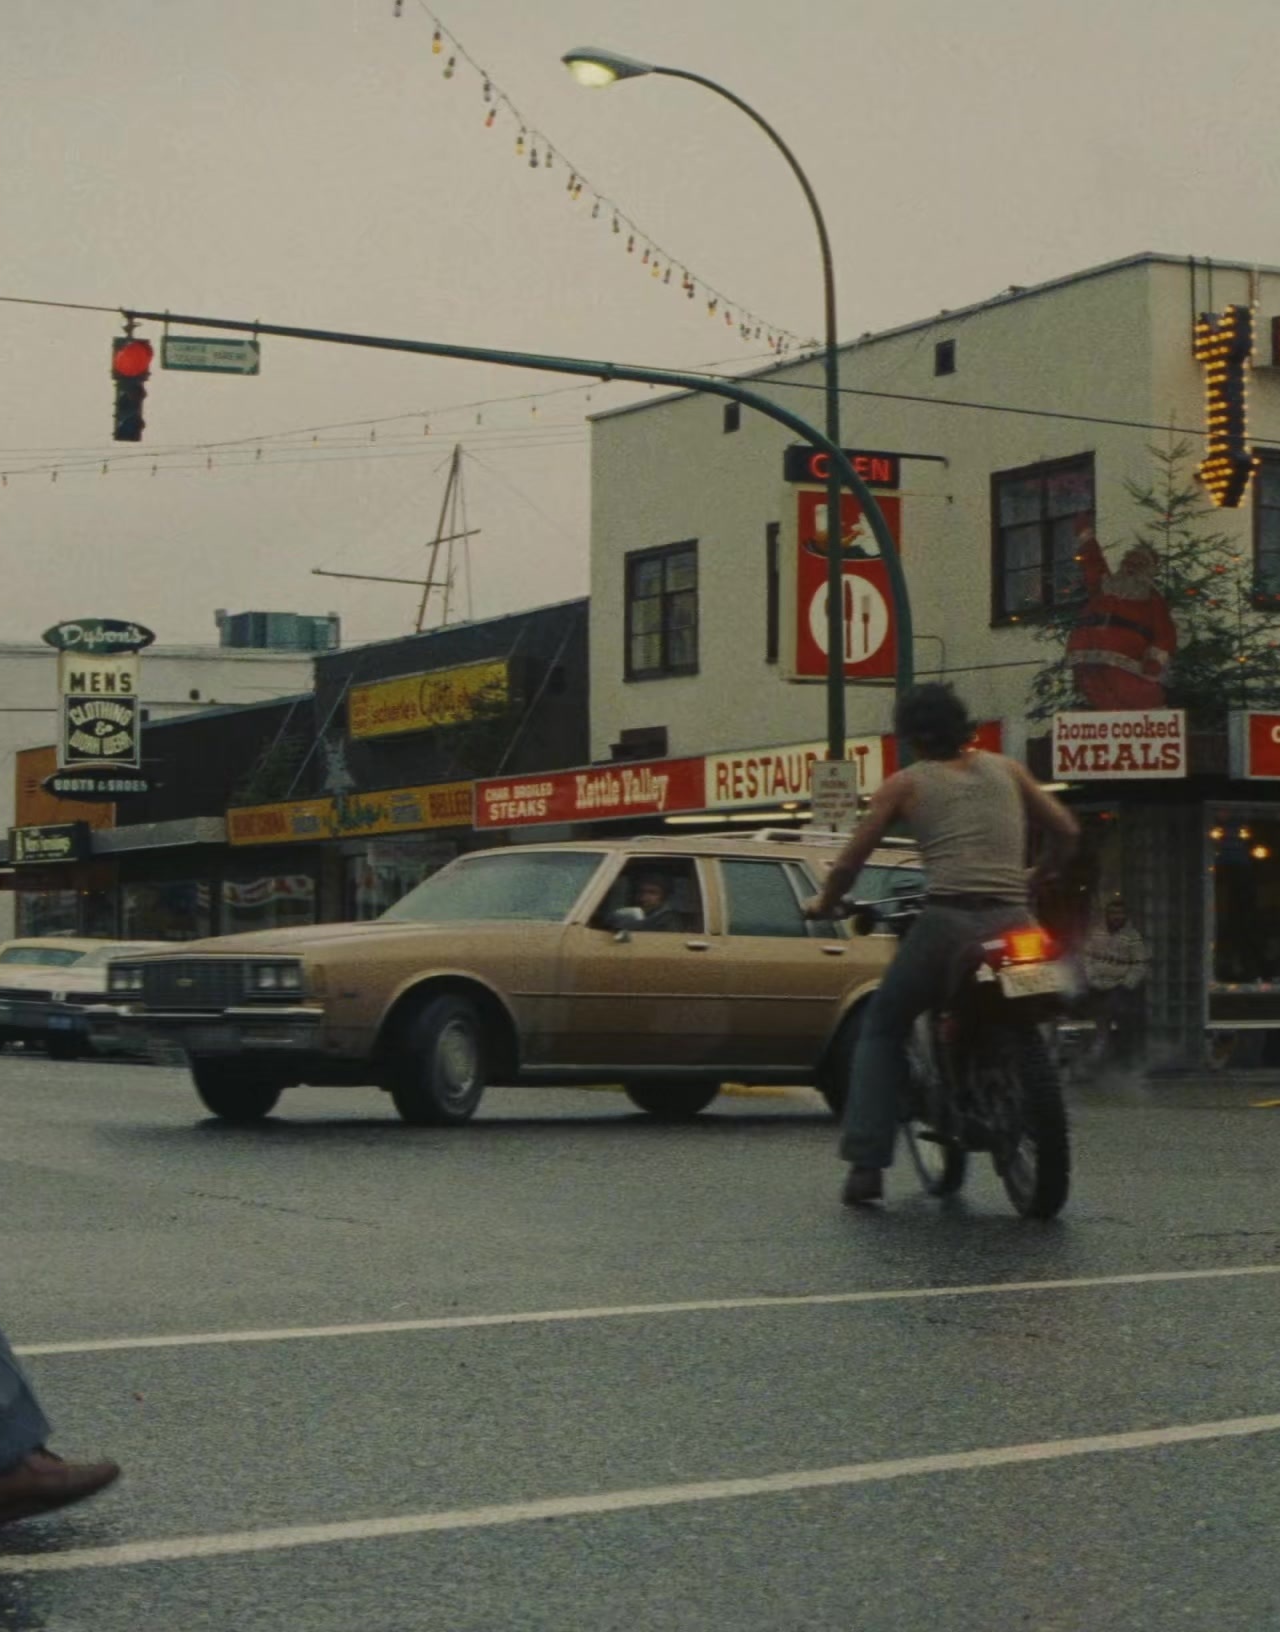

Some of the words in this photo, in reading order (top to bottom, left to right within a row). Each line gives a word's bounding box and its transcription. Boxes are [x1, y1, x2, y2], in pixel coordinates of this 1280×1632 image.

[809, 452, 890, 482] OEN
[69, 700, 133, 726] CLOTHING
[1057, 716, 1108, 740] home
[1111, 714, 1180, 739] cooked
[1057, 742, 1181, 772] MEALS
[716, 745, 869, 801] RESTAURT
[575, 771, 619, 810] Kettle
[622, 767, 669, 811] Valley
[489, 799, 547, 821] STEAKS
